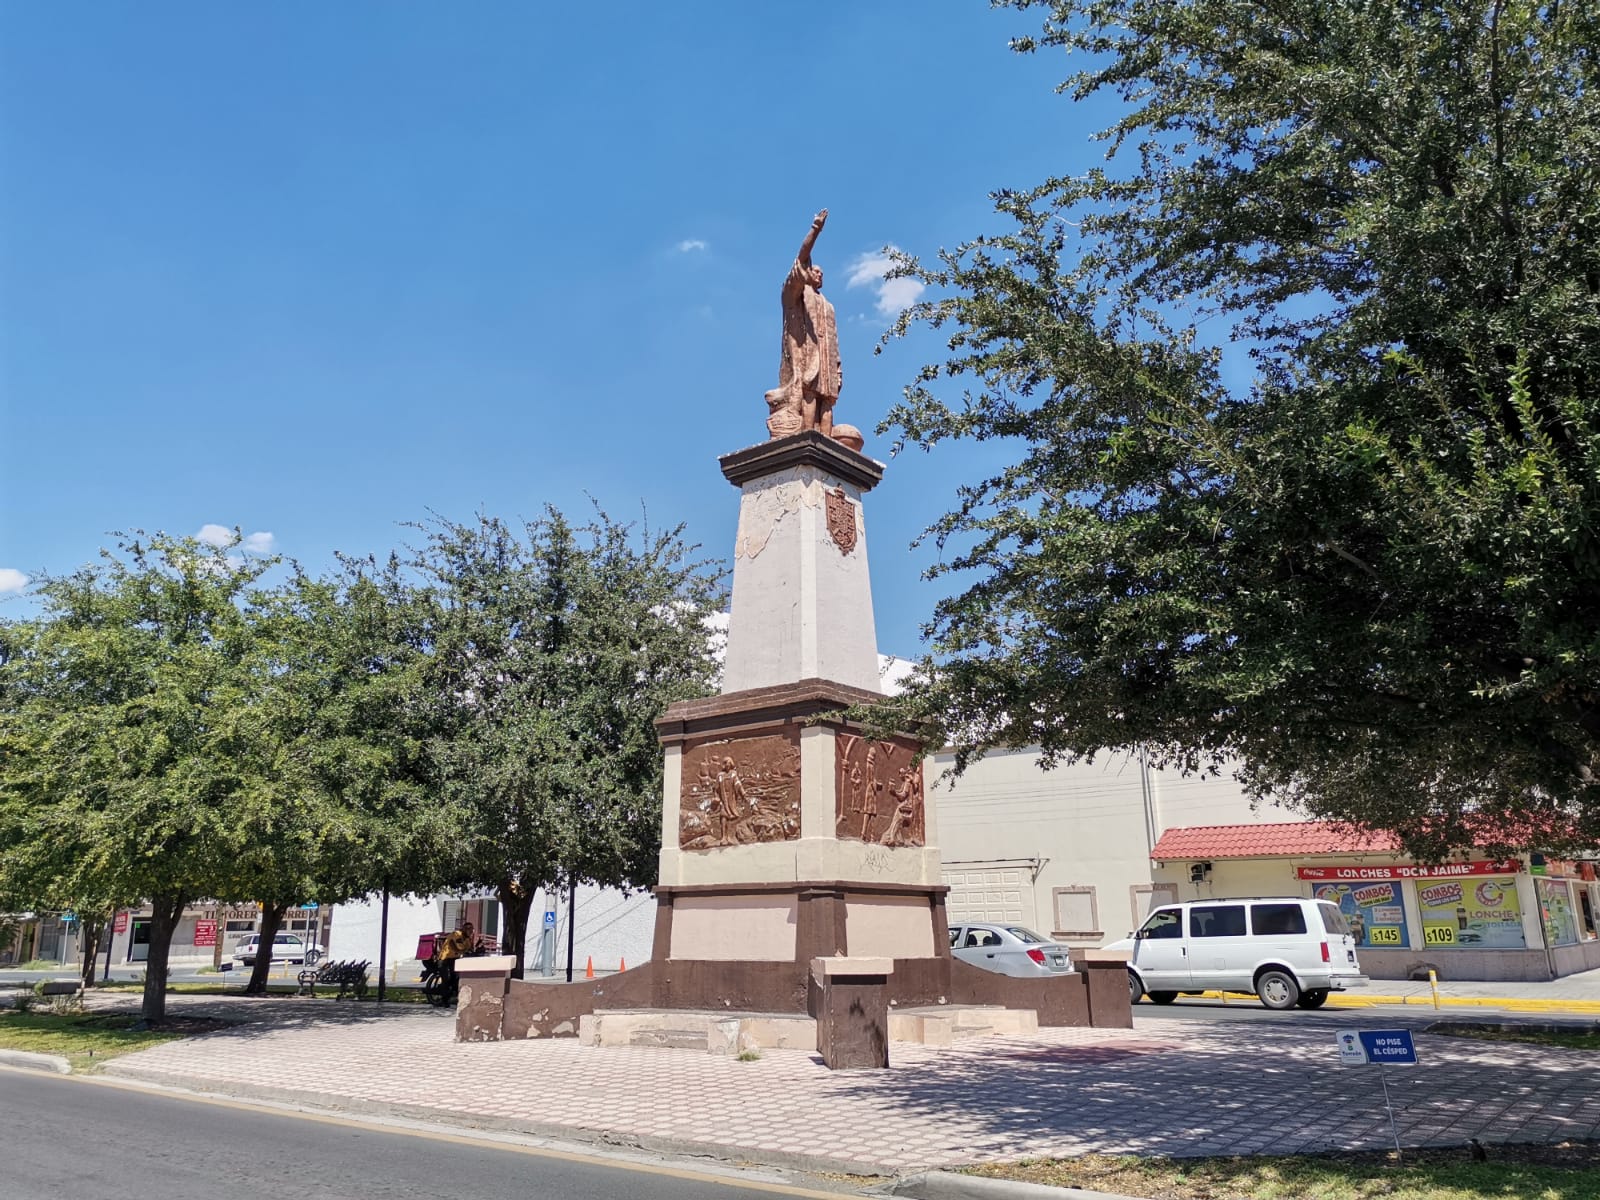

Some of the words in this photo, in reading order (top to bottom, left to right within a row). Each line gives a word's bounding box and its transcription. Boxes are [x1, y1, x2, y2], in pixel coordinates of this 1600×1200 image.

[1353, 885, 1392, 901] COMBOS
[1420, 884, 1461, 900] COMBOS
[1470, 910, 1513, 919] LONCHE
[1373, 929, 1398, 941] $145
[1426, 928, 1453, 942] $109
[1383, 1046, 1408, 1055] CÉSPED
